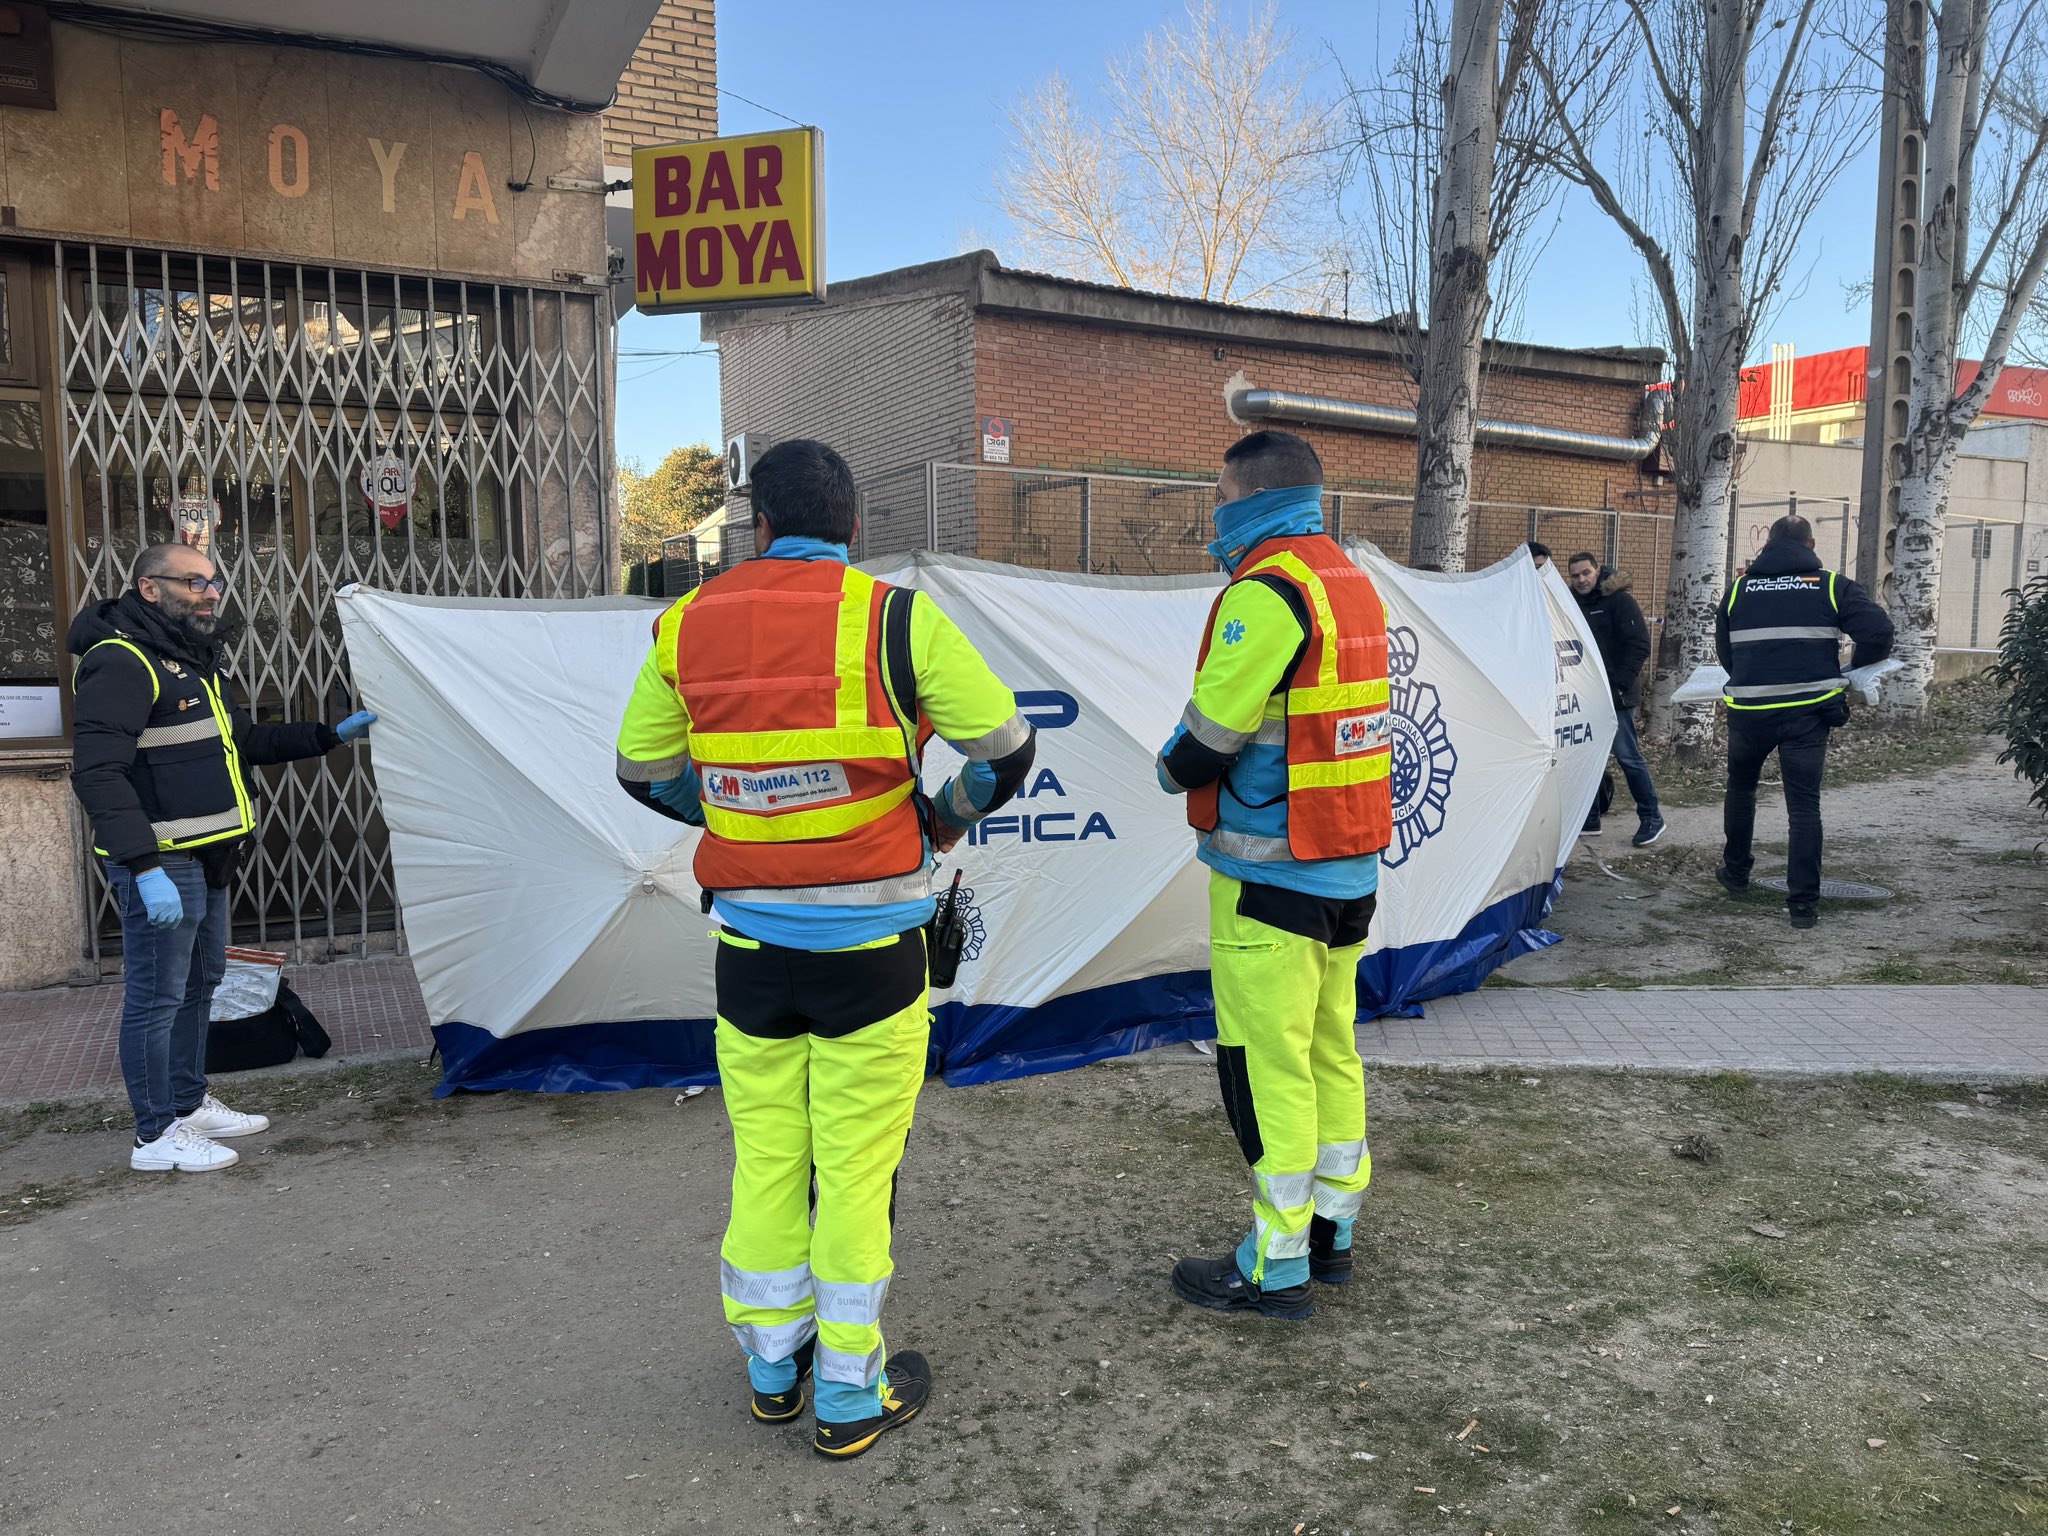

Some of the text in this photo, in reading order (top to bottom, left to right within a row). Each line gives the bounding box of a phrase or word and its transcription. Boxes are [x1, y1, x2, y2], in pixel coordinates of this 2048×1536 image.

[160, 107, 499, 224] MOYA
[655, 144, 783, 218] BAR
[636, 219, 805, 293] MOYA
[179, 509, 207, 523] AQU
[1745, 583, 1820, 593] NACIONAL
[1747, 576, 1802, 586] POLICIA
[1391, 717, 1429, 763] CIONAL DE
[742, 774, 800, 793] SUMMA
[803, 769, 831, 785] 112
[968, 811, 1117, 846] IFICA
[826, 885, 877, 894] SUMMA 112
[837, 1297, 868, 1309] SUMMA
